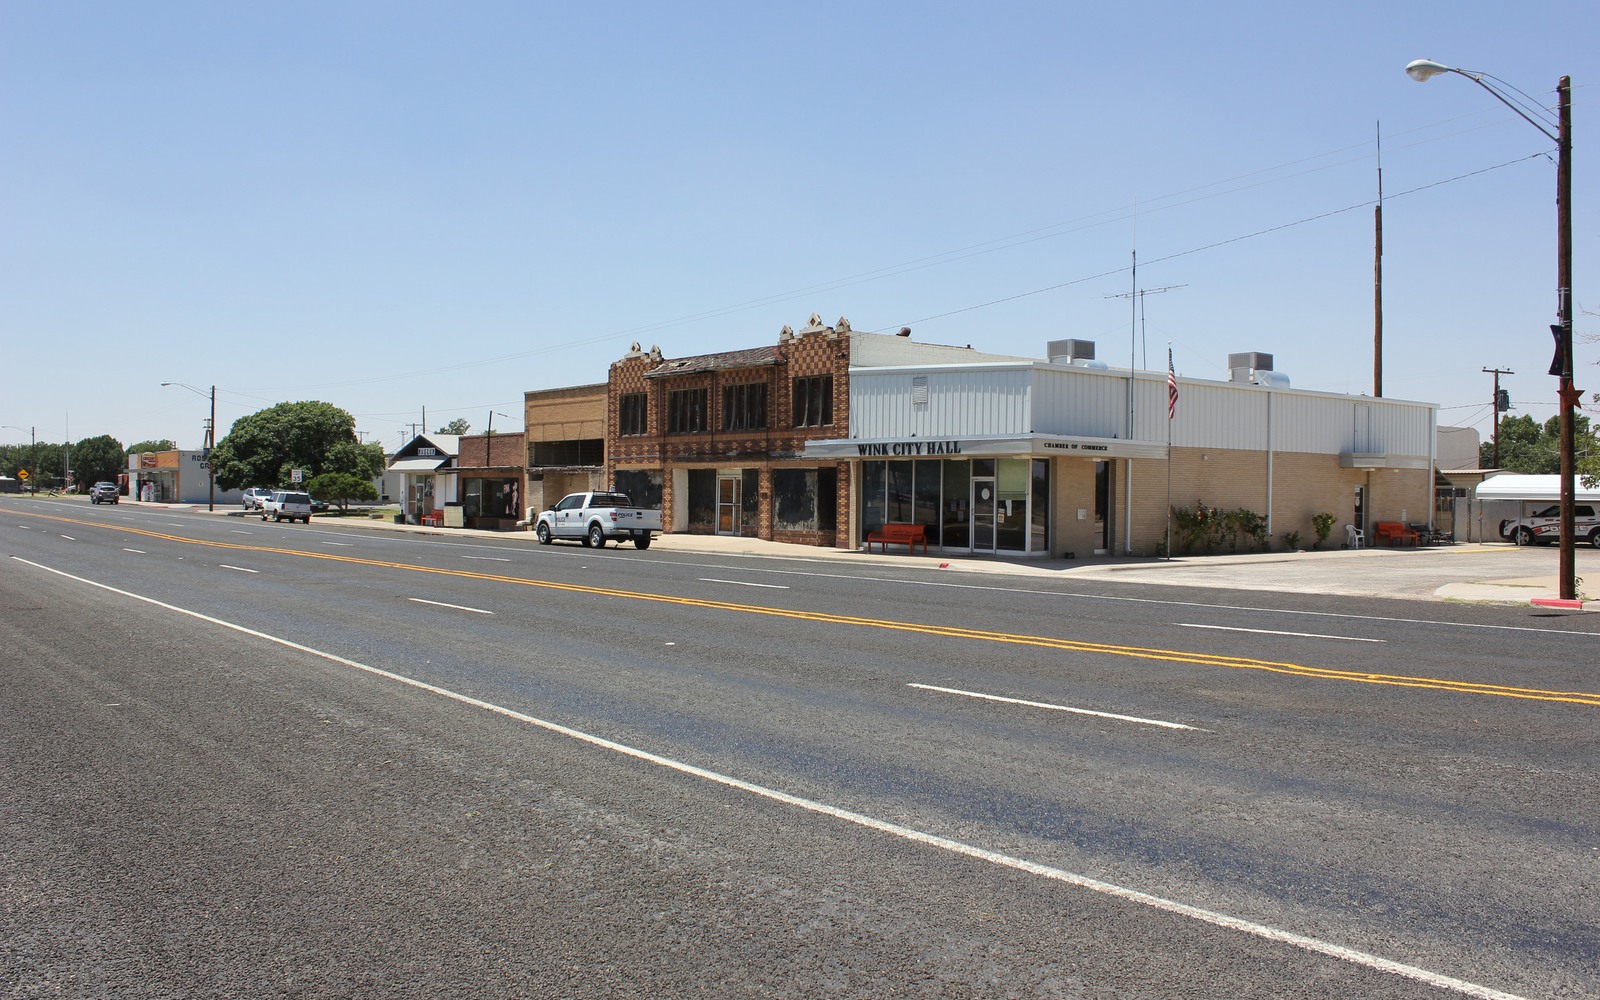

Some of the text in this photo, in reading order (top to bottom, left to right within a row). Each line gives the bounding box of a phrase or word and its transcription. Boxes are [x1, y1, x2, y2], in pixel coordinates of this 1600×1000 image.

[858, 441, 961, 456] WINK CITY HALL
